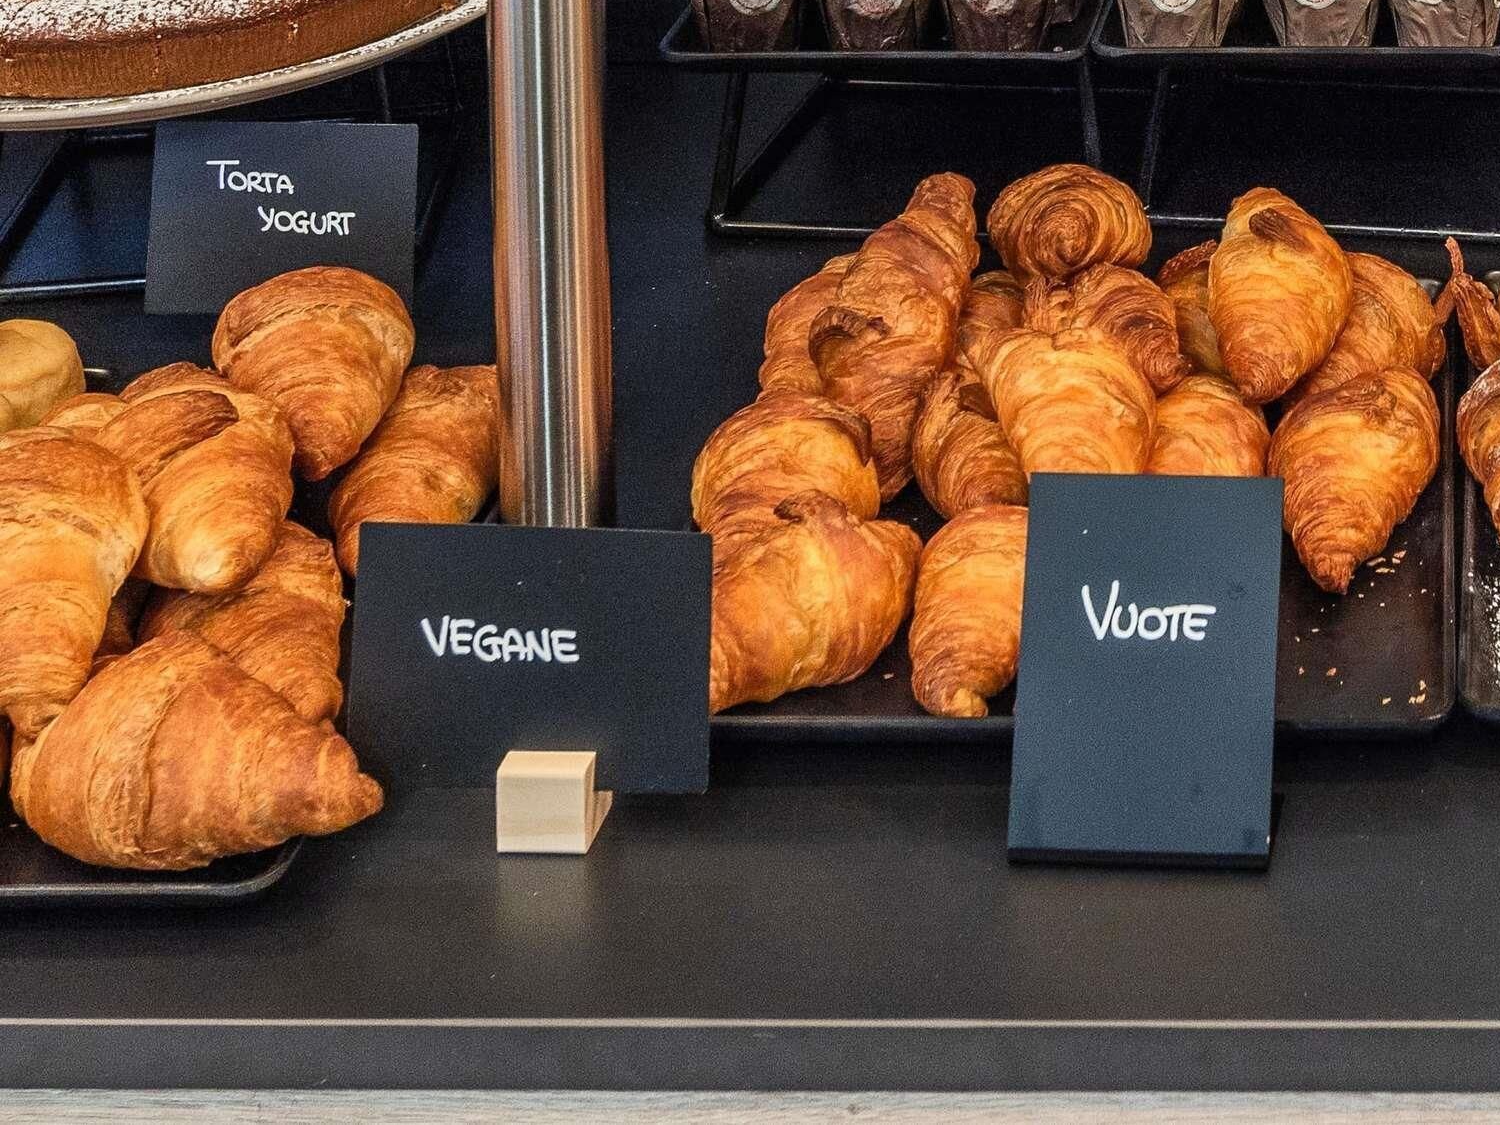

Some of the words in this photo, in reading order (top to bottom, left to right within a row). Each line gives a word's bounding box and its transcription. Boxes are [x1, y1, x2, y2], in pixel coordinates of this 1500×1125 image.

[206, 159, 295, 195] TORTA
[257, 205, 356, 236] YOGURT
[1081, 579, 1217, 642] VUOTE
[420, 614, 581, 663] VEGANE
